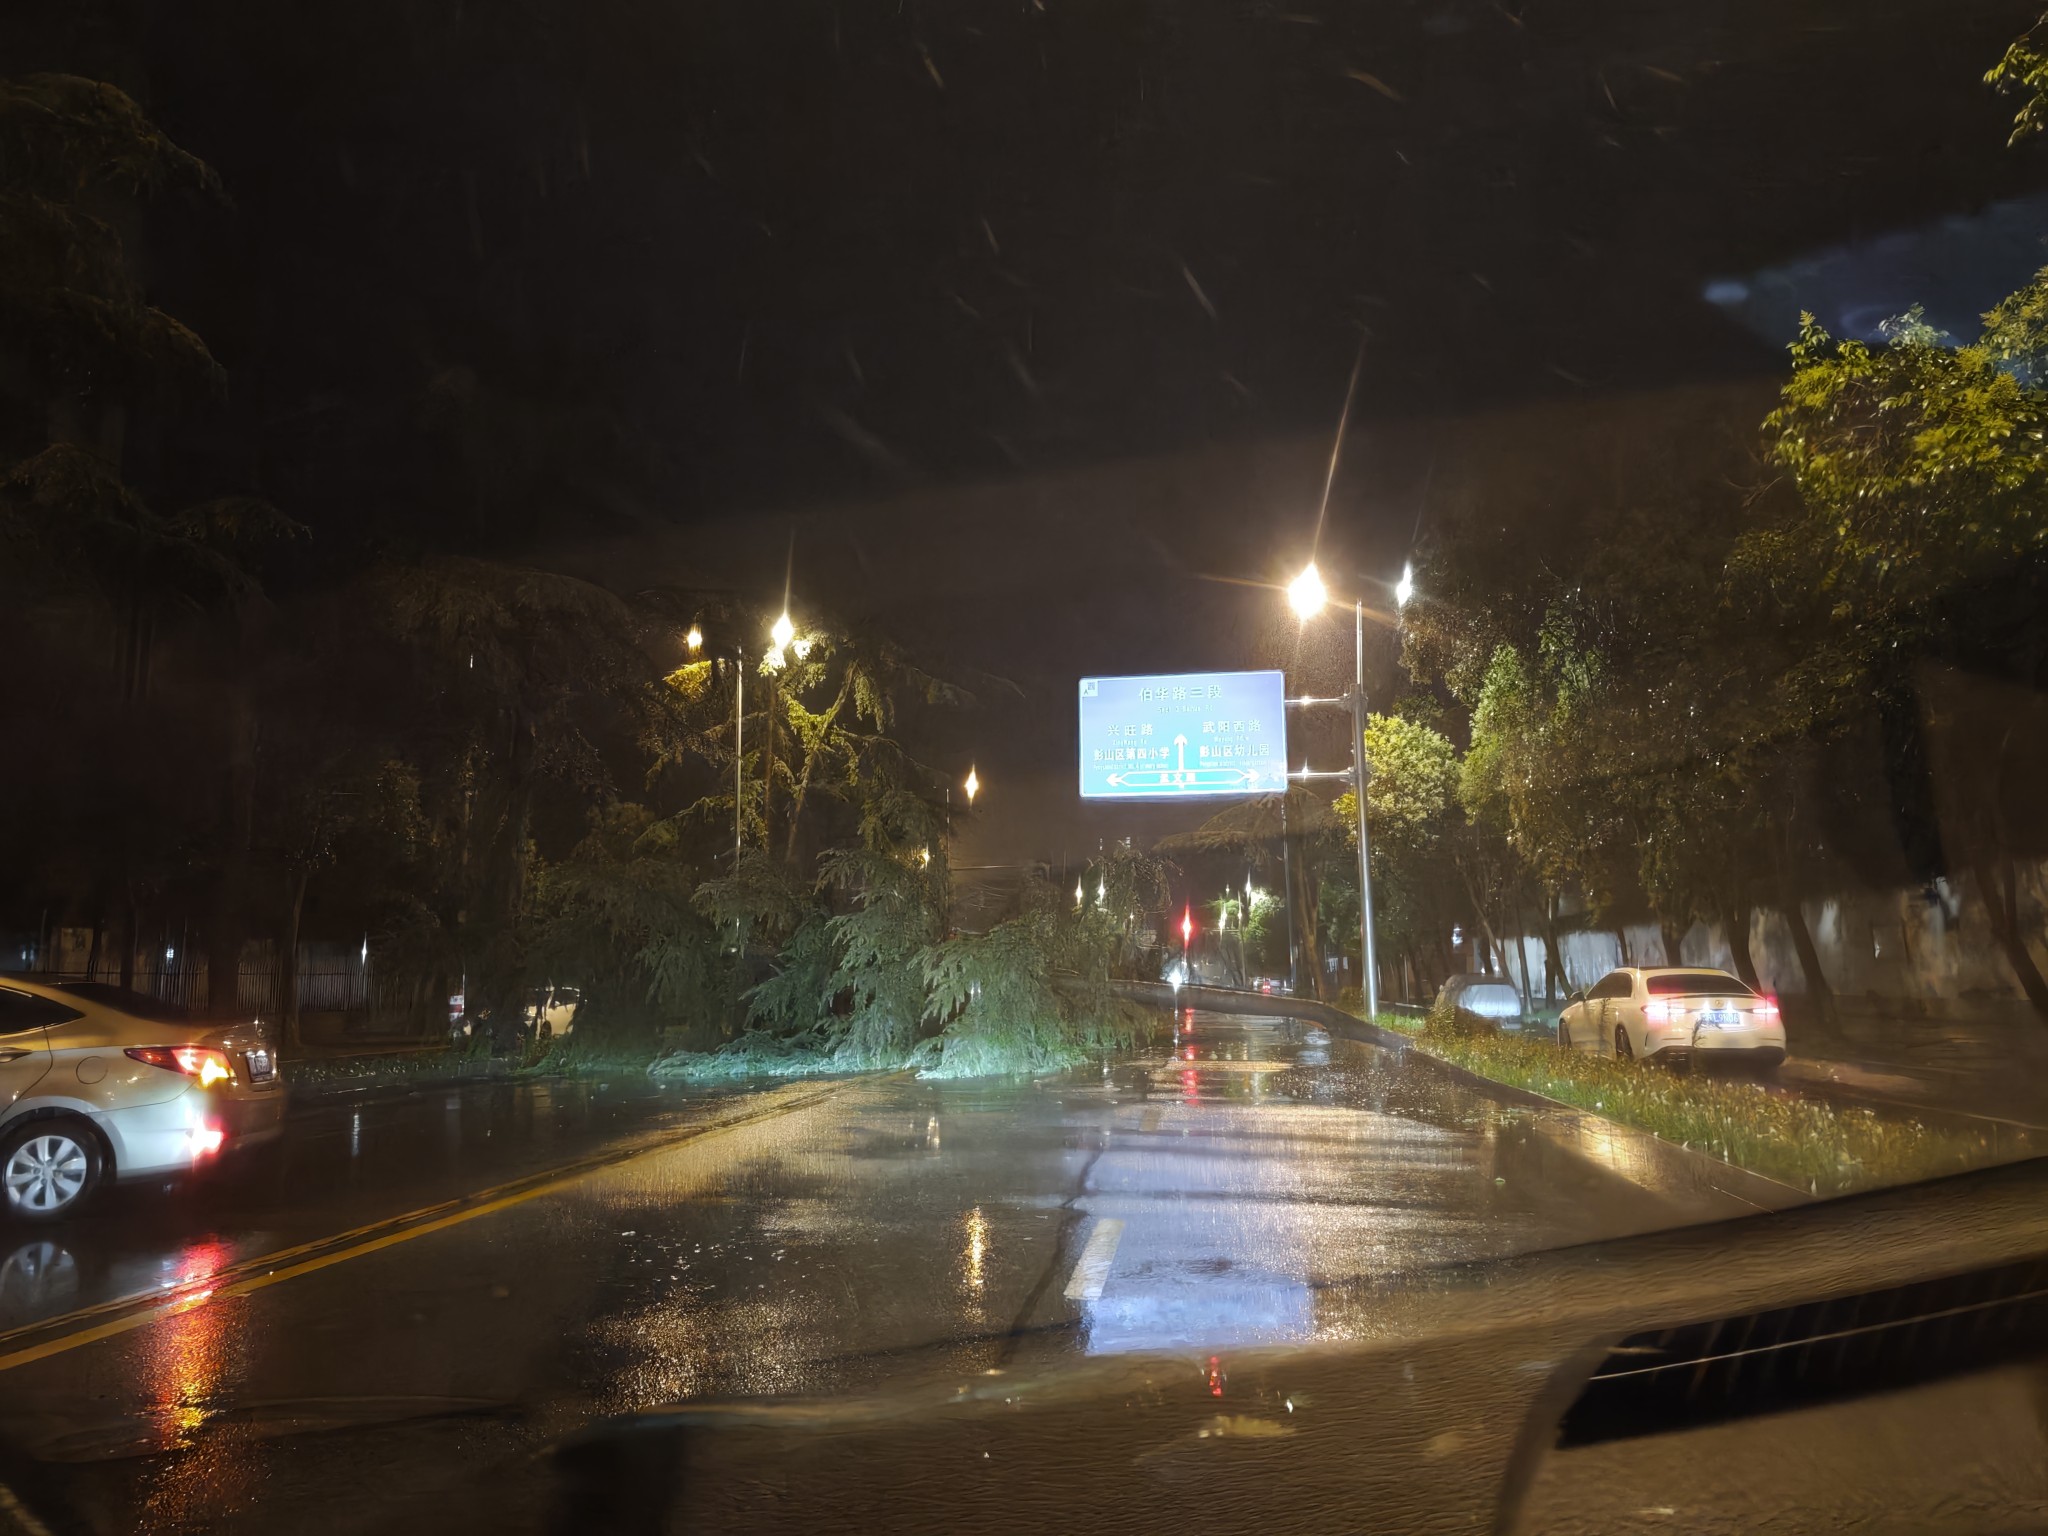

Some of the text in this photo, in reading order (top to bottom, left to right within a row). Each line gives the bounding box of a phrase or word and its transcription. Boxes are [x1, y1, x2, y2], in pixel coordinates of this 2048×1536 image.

[1138, 684, 1222, 702] 伯华路三段
[1107, 723, 1153, 736] 兴旺路
[1202, 719, 1262, 733] 武阳西路
